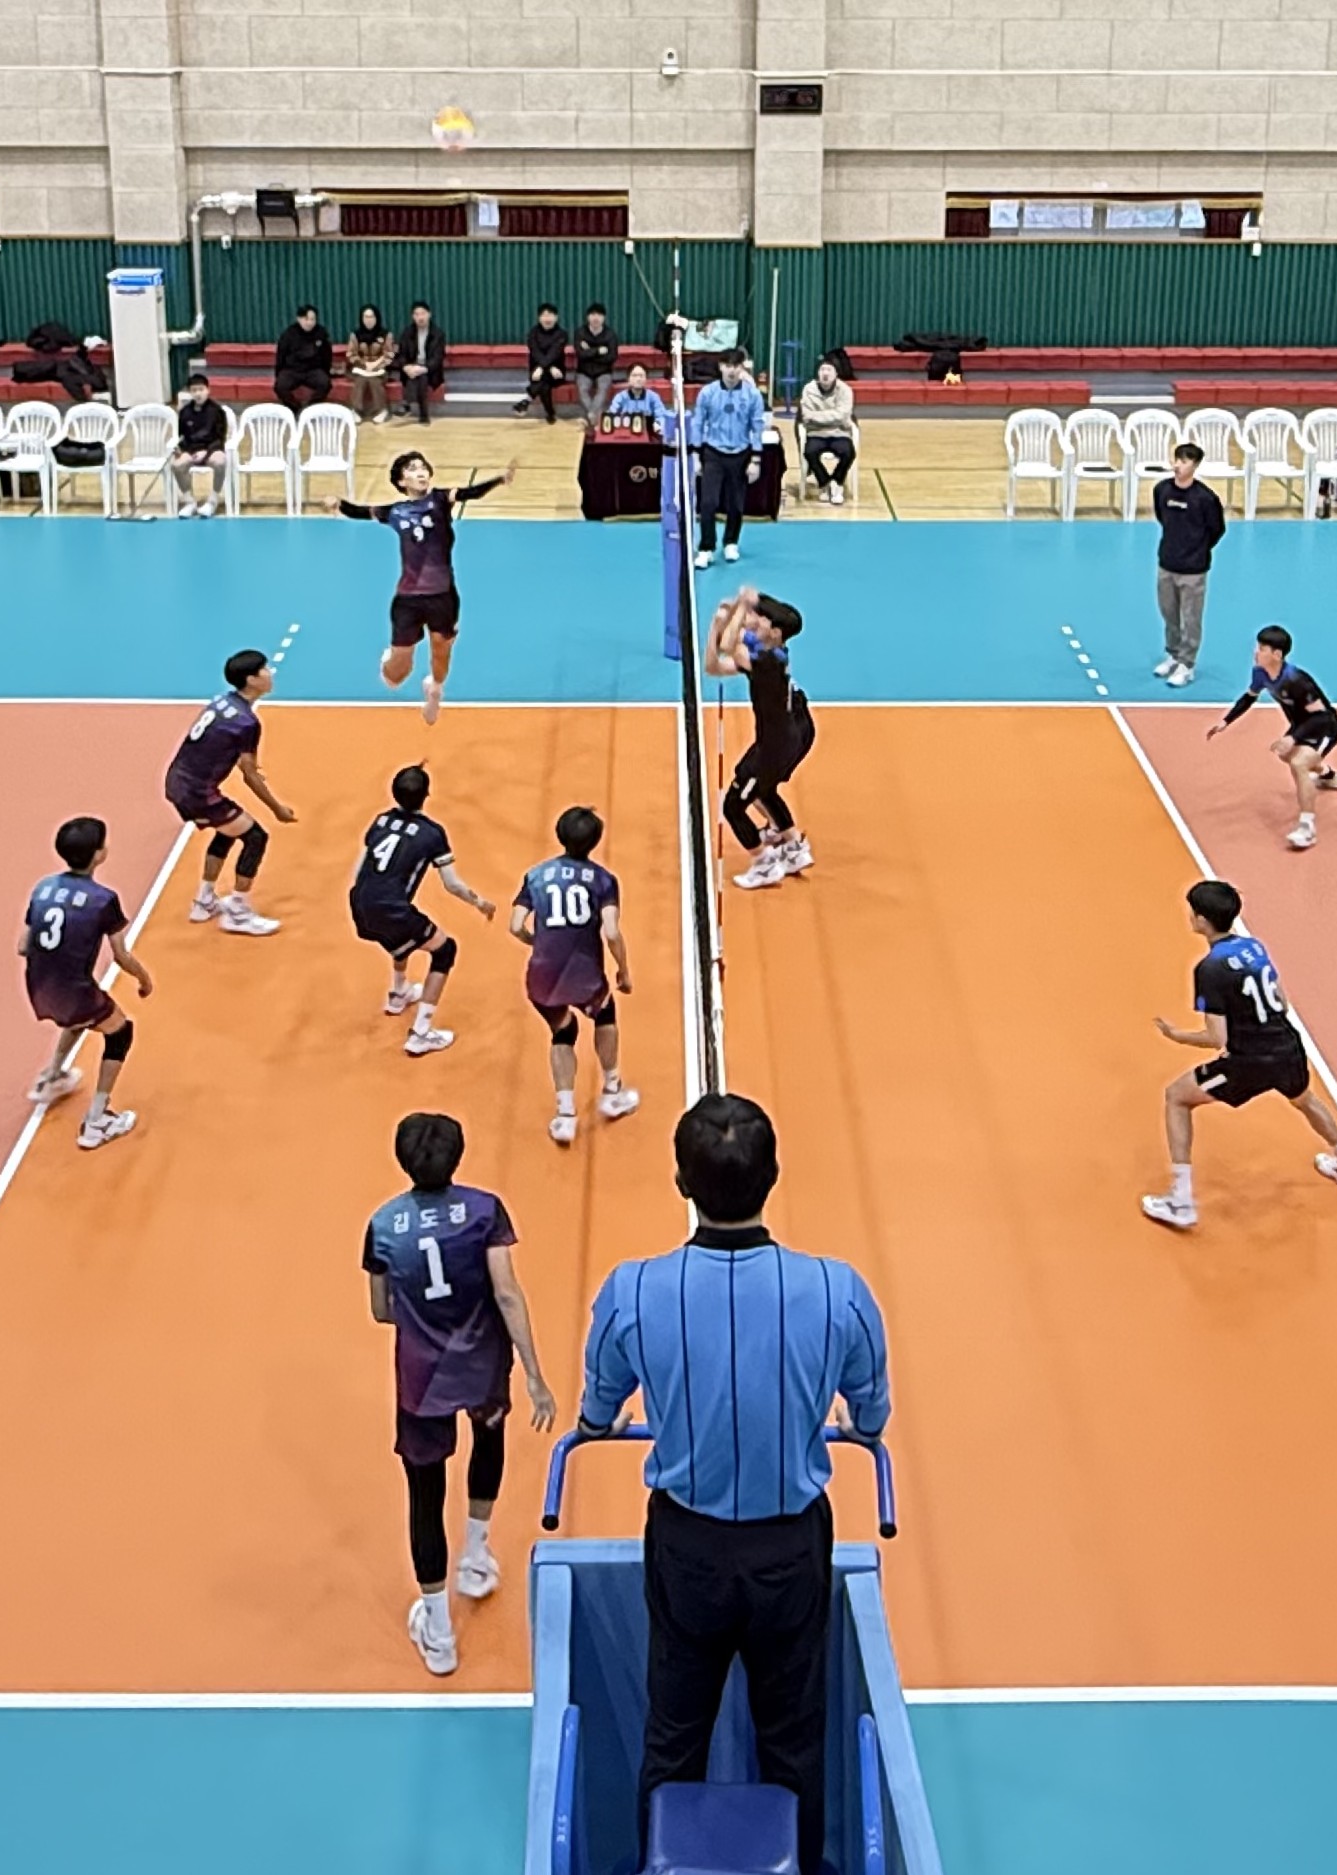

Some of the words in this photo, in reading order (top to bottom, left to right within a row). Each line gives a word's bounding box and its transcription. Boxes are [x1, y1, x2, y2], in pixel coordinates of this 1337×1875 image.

[413, 526, 424, 542] 9
[190, 709, 216, 741] 8
[373, 833, 401, 872] 4
[546, 884, 592, 926] 10
[39, 907, 65, 951] 3
[418, 1236, 453, 1300] 1
